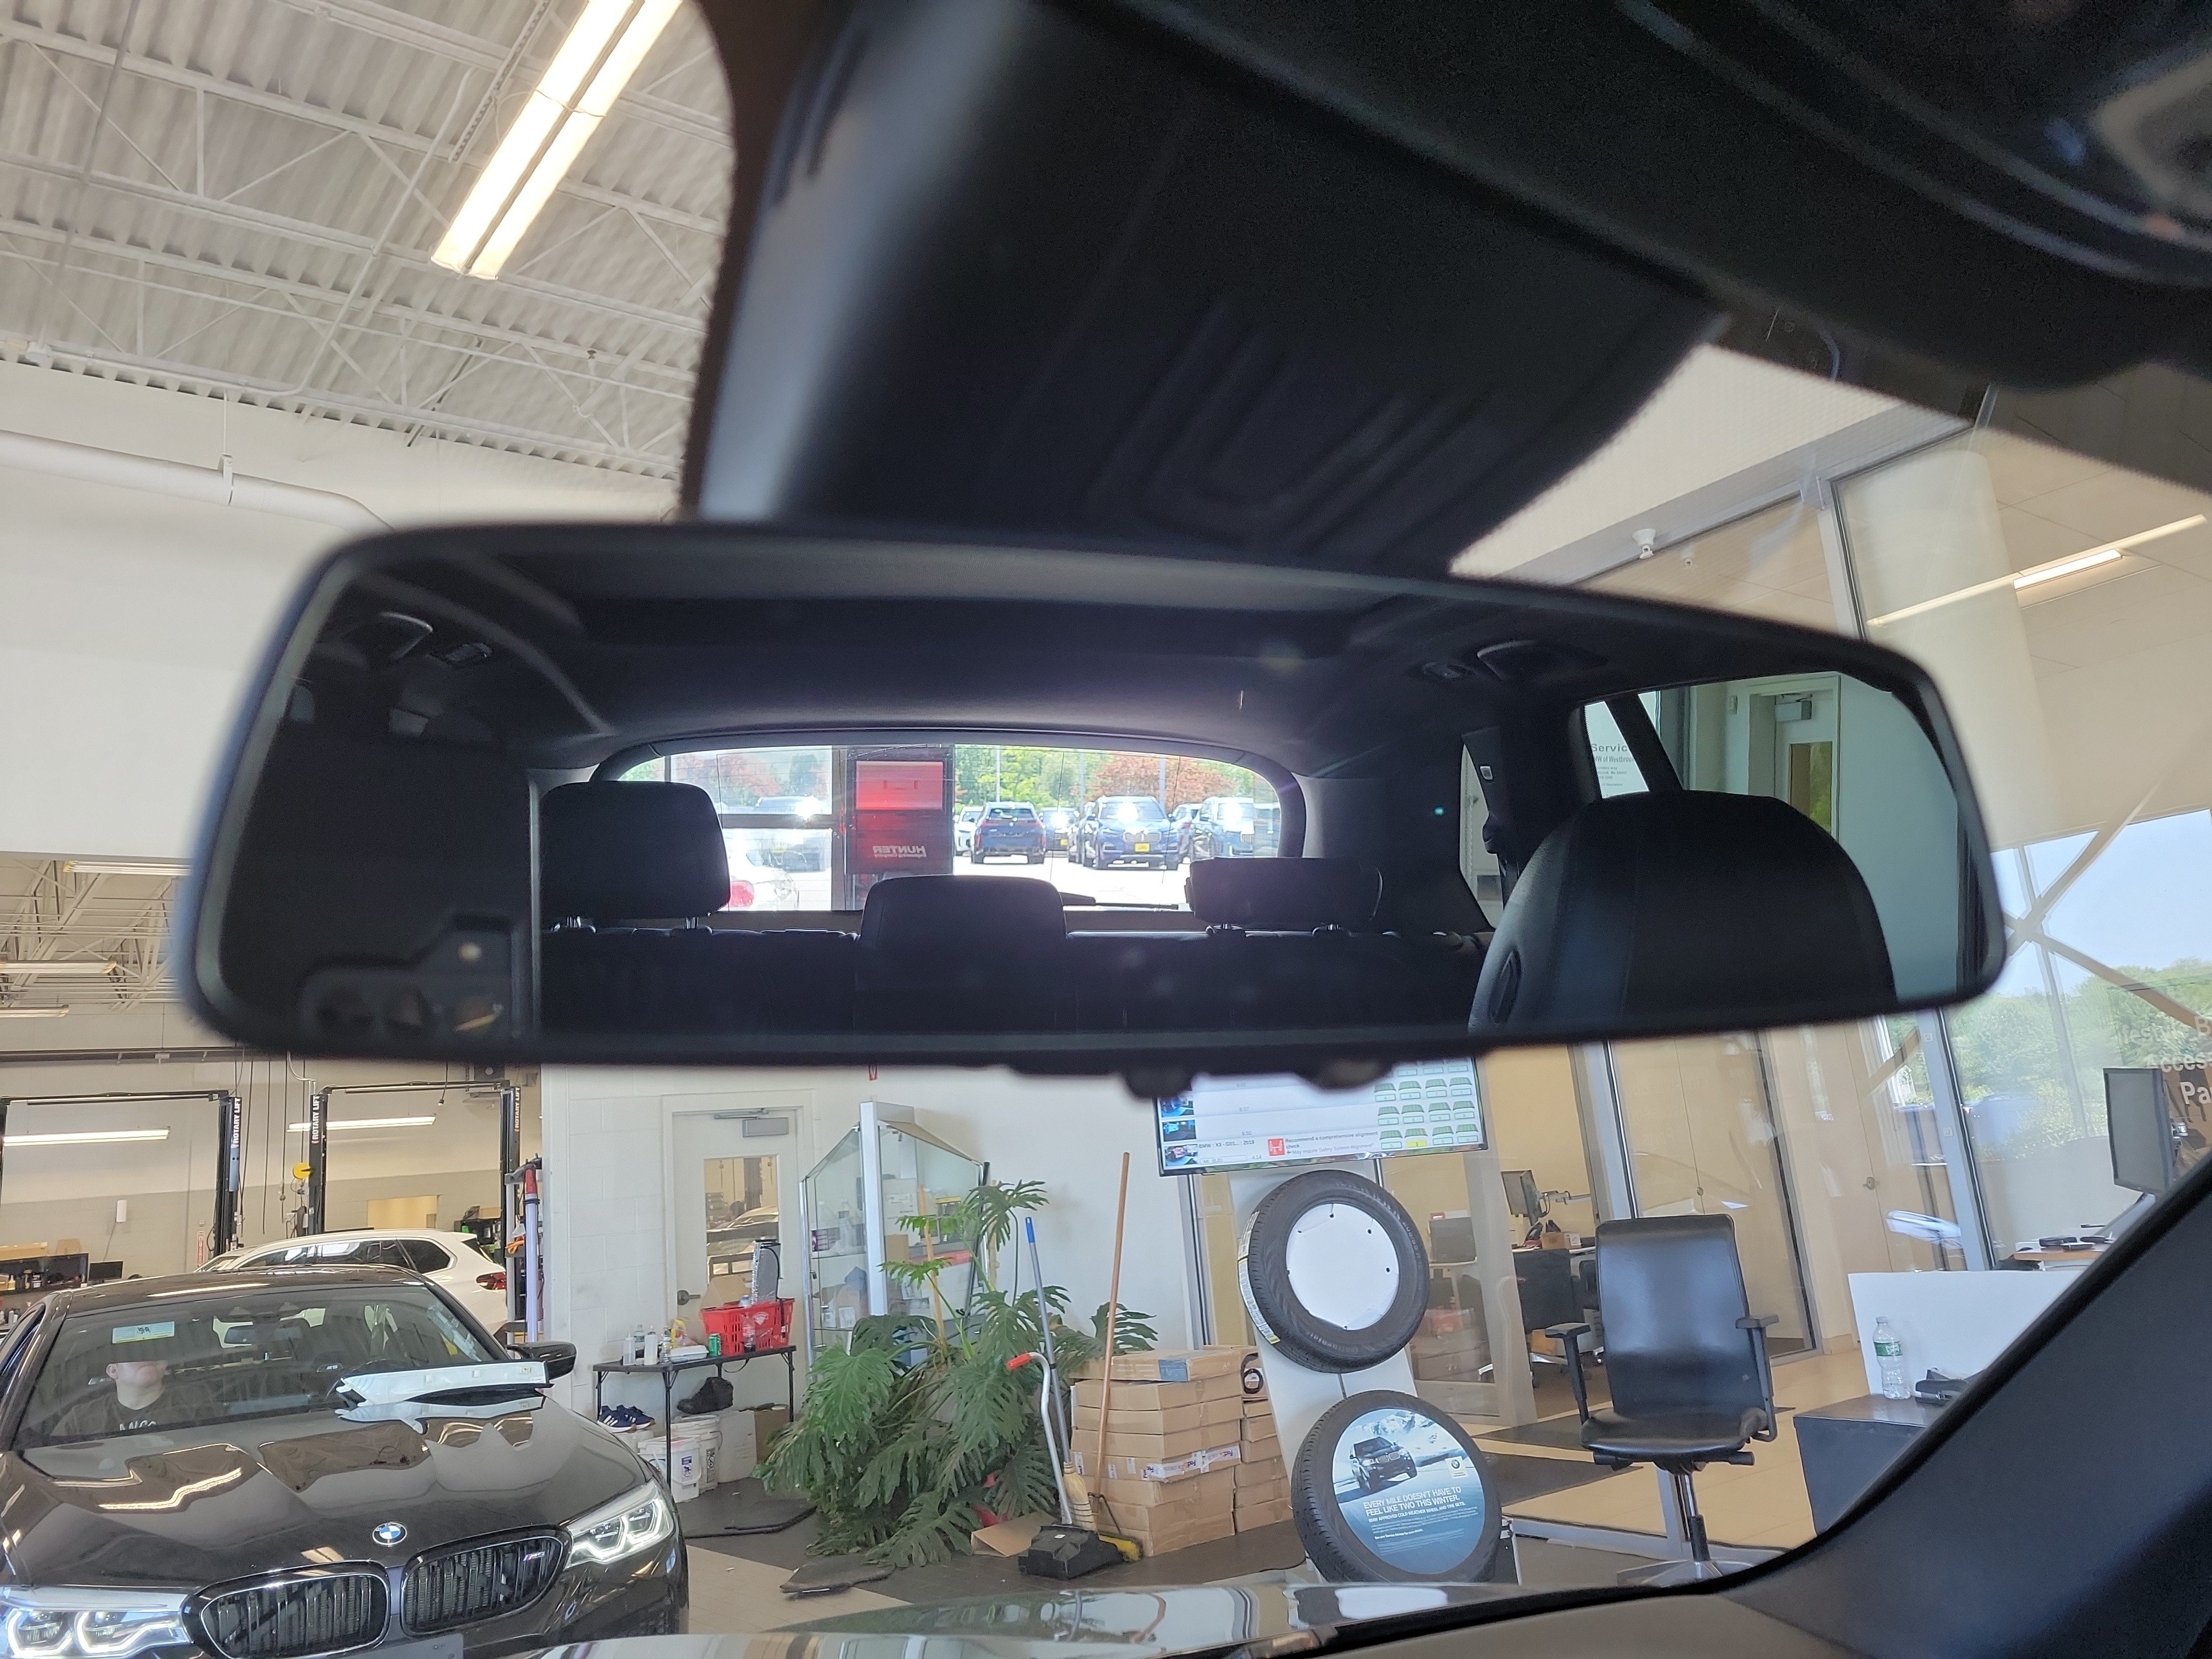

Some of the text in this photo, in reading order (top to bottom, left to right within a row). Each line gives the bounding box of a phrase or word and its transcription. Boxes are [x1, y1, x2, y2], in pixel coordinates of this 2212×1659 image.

[2180, 1081, 2212, 1105] Pa
[1363, 1499, 1385, 1509] EVERY
[1386, 1496, 1402, 1505] MILE
[1403, 1490, 1431, 1502] DOESN'T
[1431, 1487, 1452, 1497] HAVE
[1366, 1494, 1460, 1516] FEEL LIKE TWO THIS WINTER.
[1379, 1513, 1397, 1521] APPROVED
